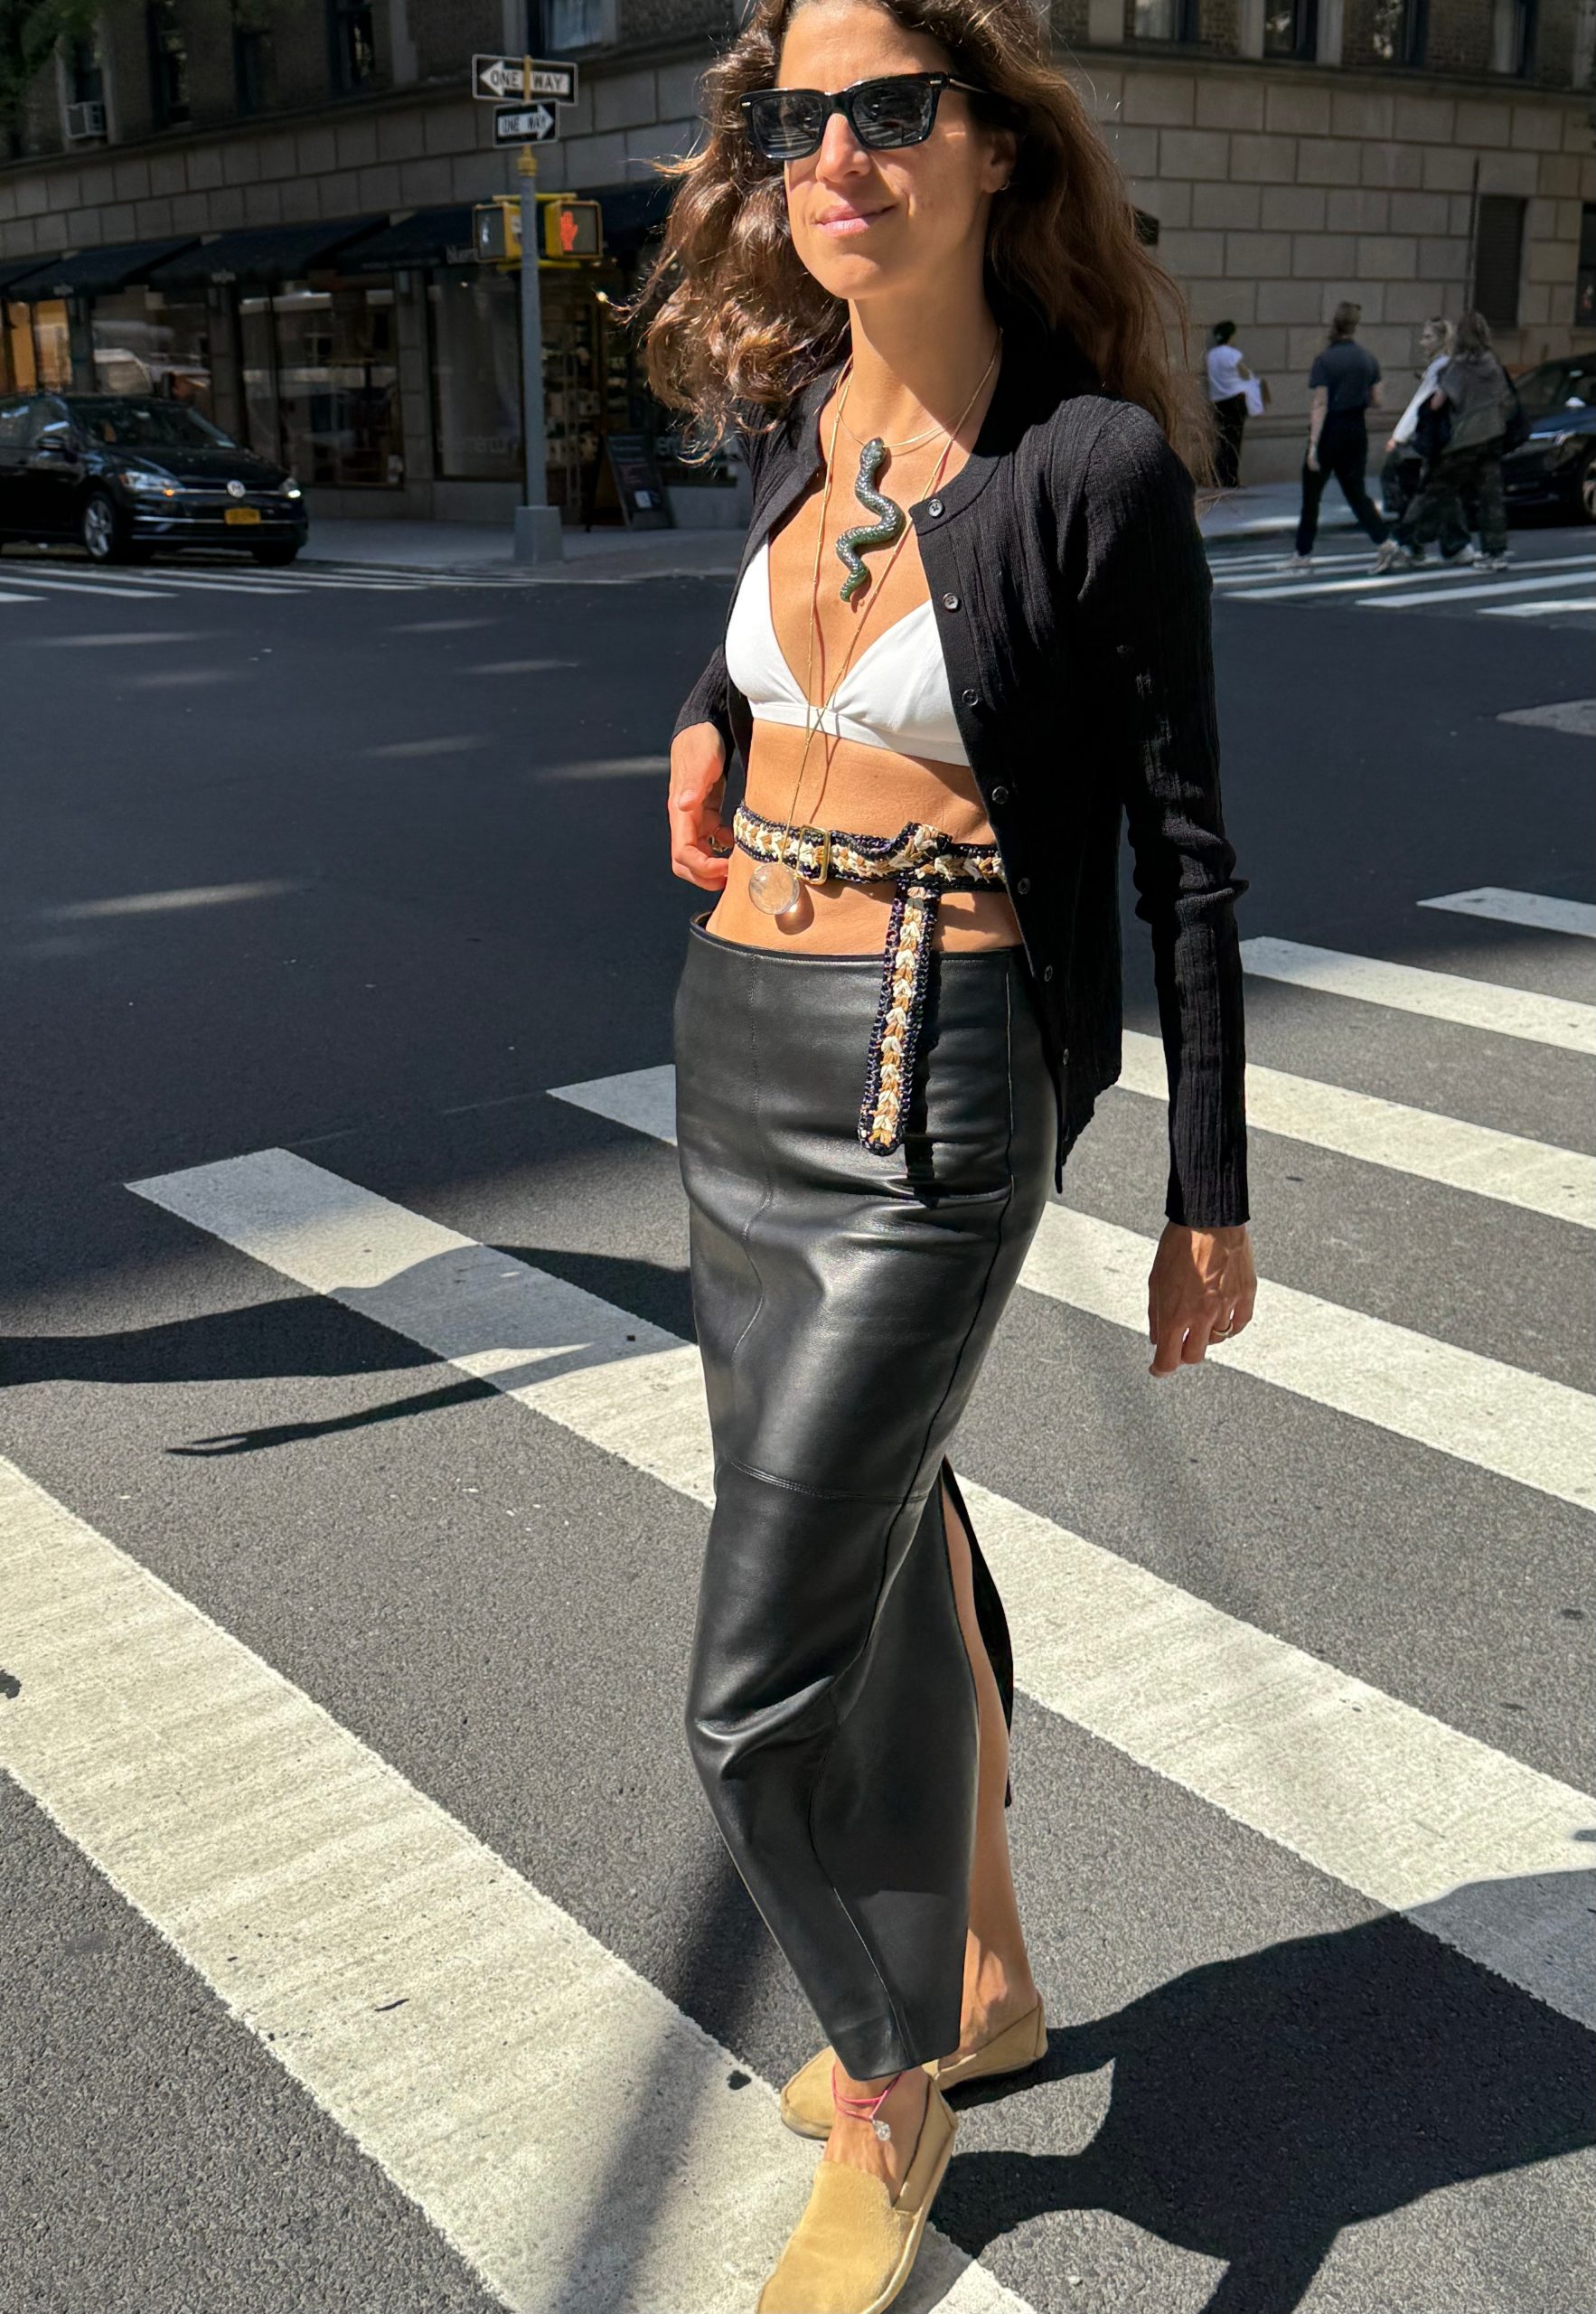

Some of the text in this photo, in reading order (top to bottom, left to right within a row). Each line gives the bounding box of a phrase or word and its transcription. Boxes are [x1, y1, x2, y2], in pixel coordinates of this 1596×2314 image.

[490, 70, 562, 91] ONE WAY
[503, 115, 546, 133] ONE WAY
